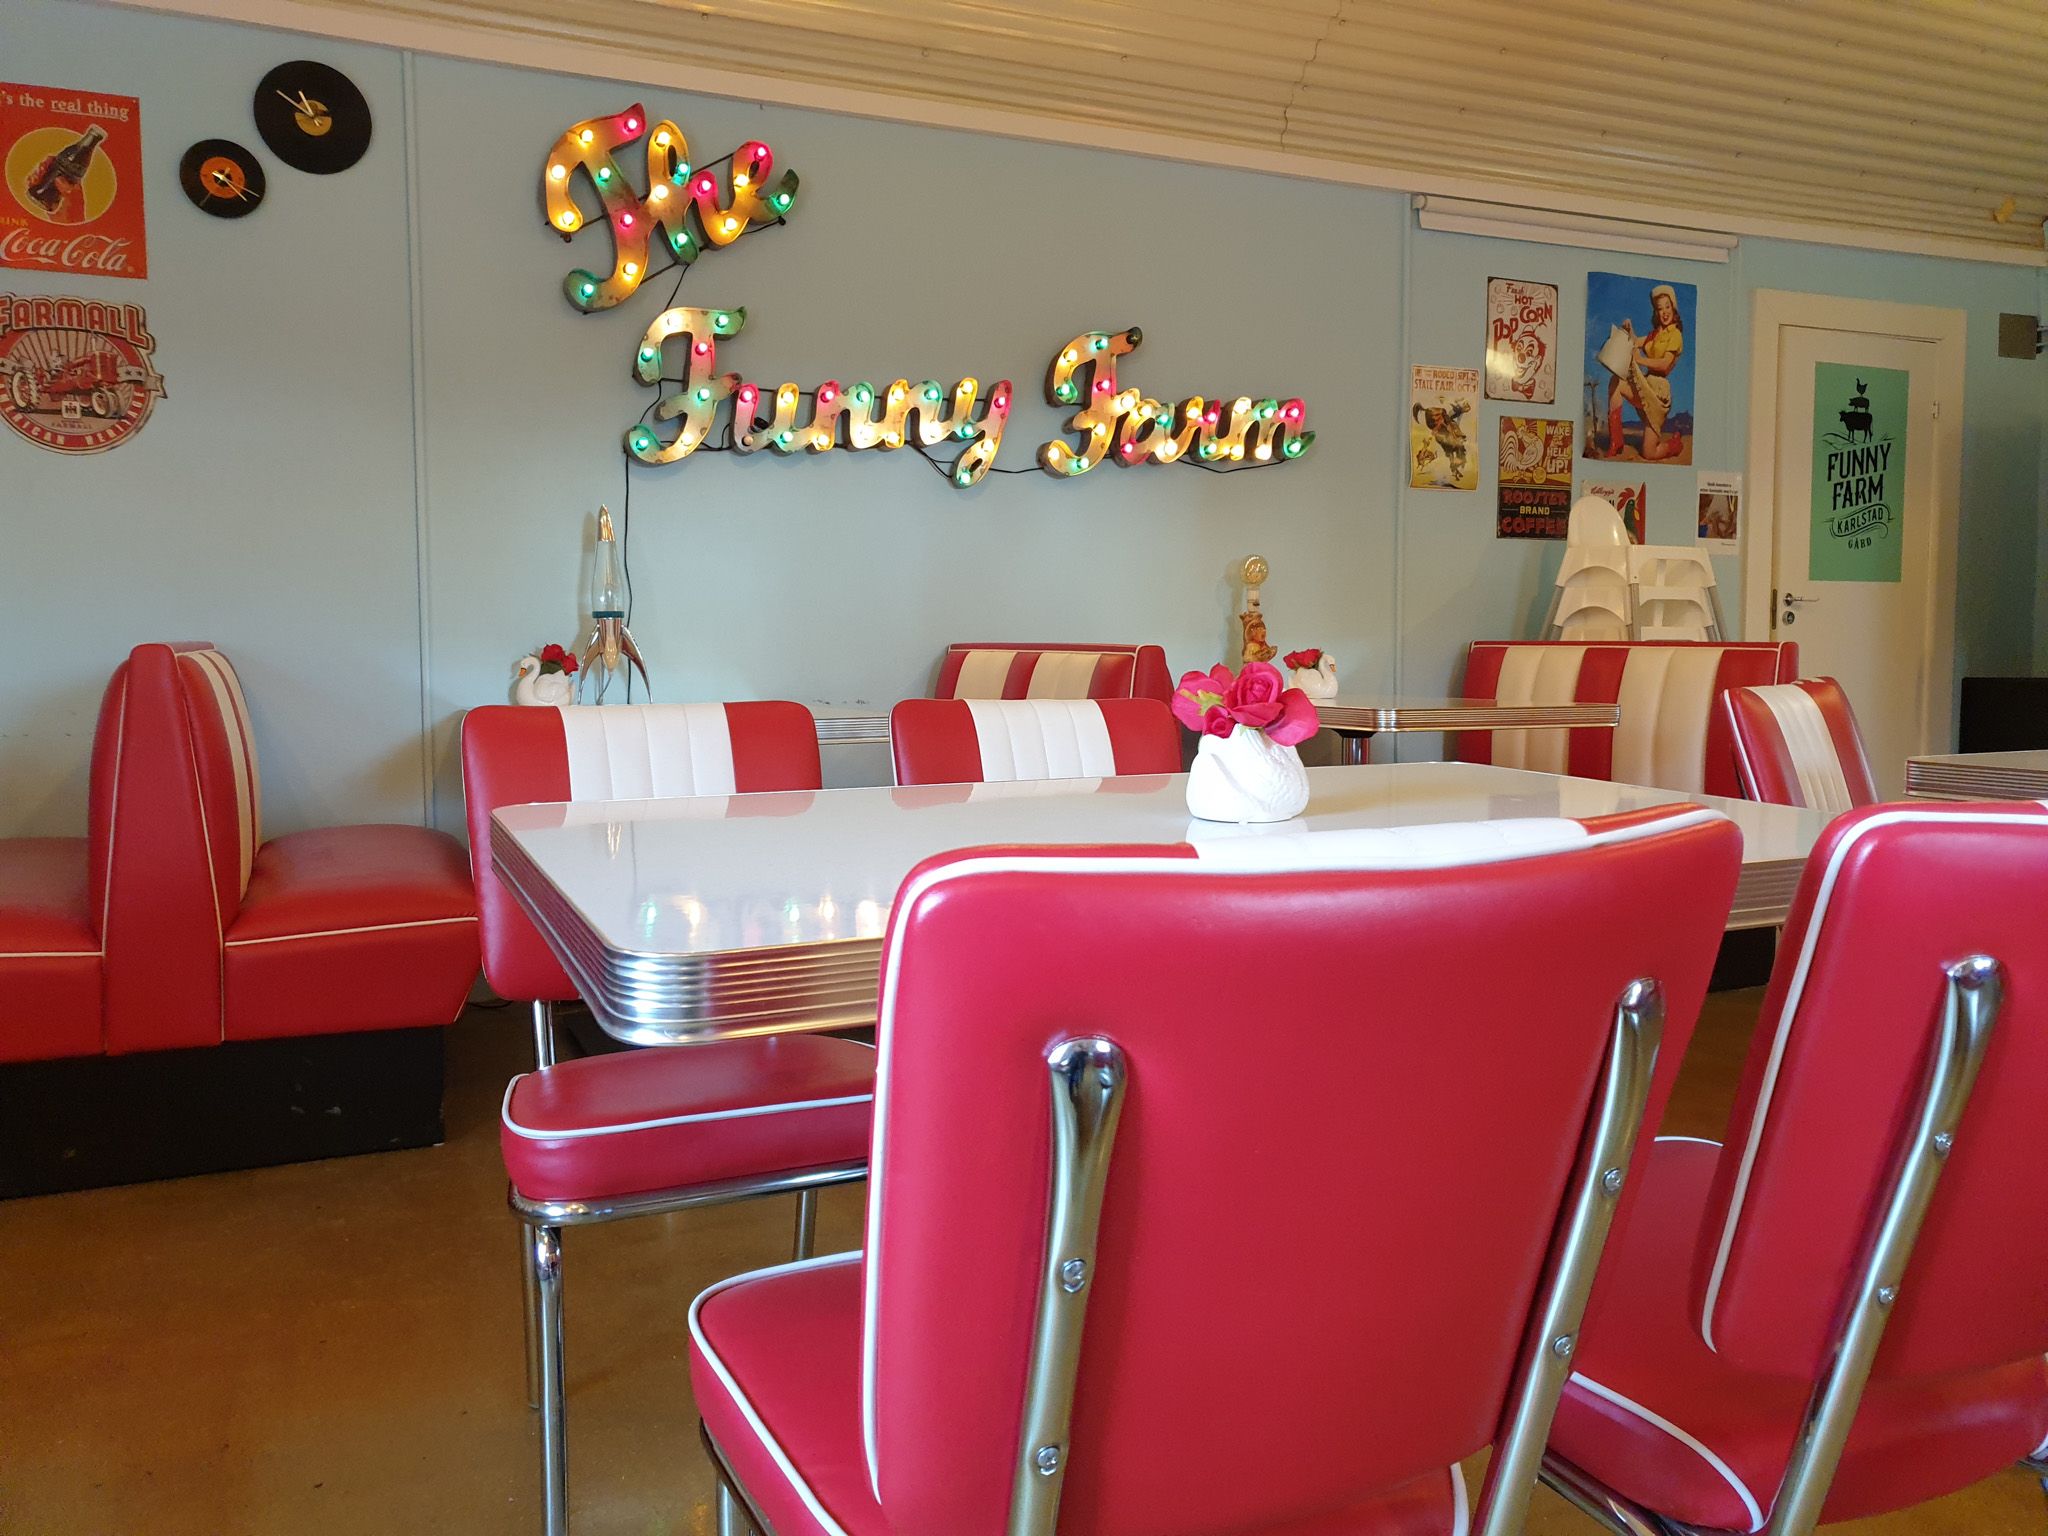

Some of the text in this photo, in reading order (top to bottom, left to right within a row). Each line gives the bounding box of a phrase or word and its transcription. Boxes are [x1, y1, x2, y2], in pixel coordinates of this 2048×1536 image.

[20, 93, 44, 108] the
[51, 99, 81, 113] real
[87, 101, 129, 122] thing
[544, 102, 799, 312] The
[0, 228, 132, 271] Coca-Cola
[1515, 295, 1534, 305] HOT
[1520, 301, 1553, 323] CORN
[1493, 318, 1518, 345] POP
[1414, 379, 1454, 391] STATE FAIR
[624, 306, 1315, 489] Funny Farm
[1546, 425, 1571, 436] WAKE
[1547, 447, 1569, 458] HELL
[1827, 443, 1891, 481] FUNNY
[1546, 459, 1569, 474] UP!
[1503, 489, 1567, 505] ROOSTER
[1833, 474, 1884, 511] FARM
[1519, 506, 1551, 515] BRAND
[1837, 508, 1884, 534] KARLSTAD
[1502, 517, 1567, 536] COFFEE
